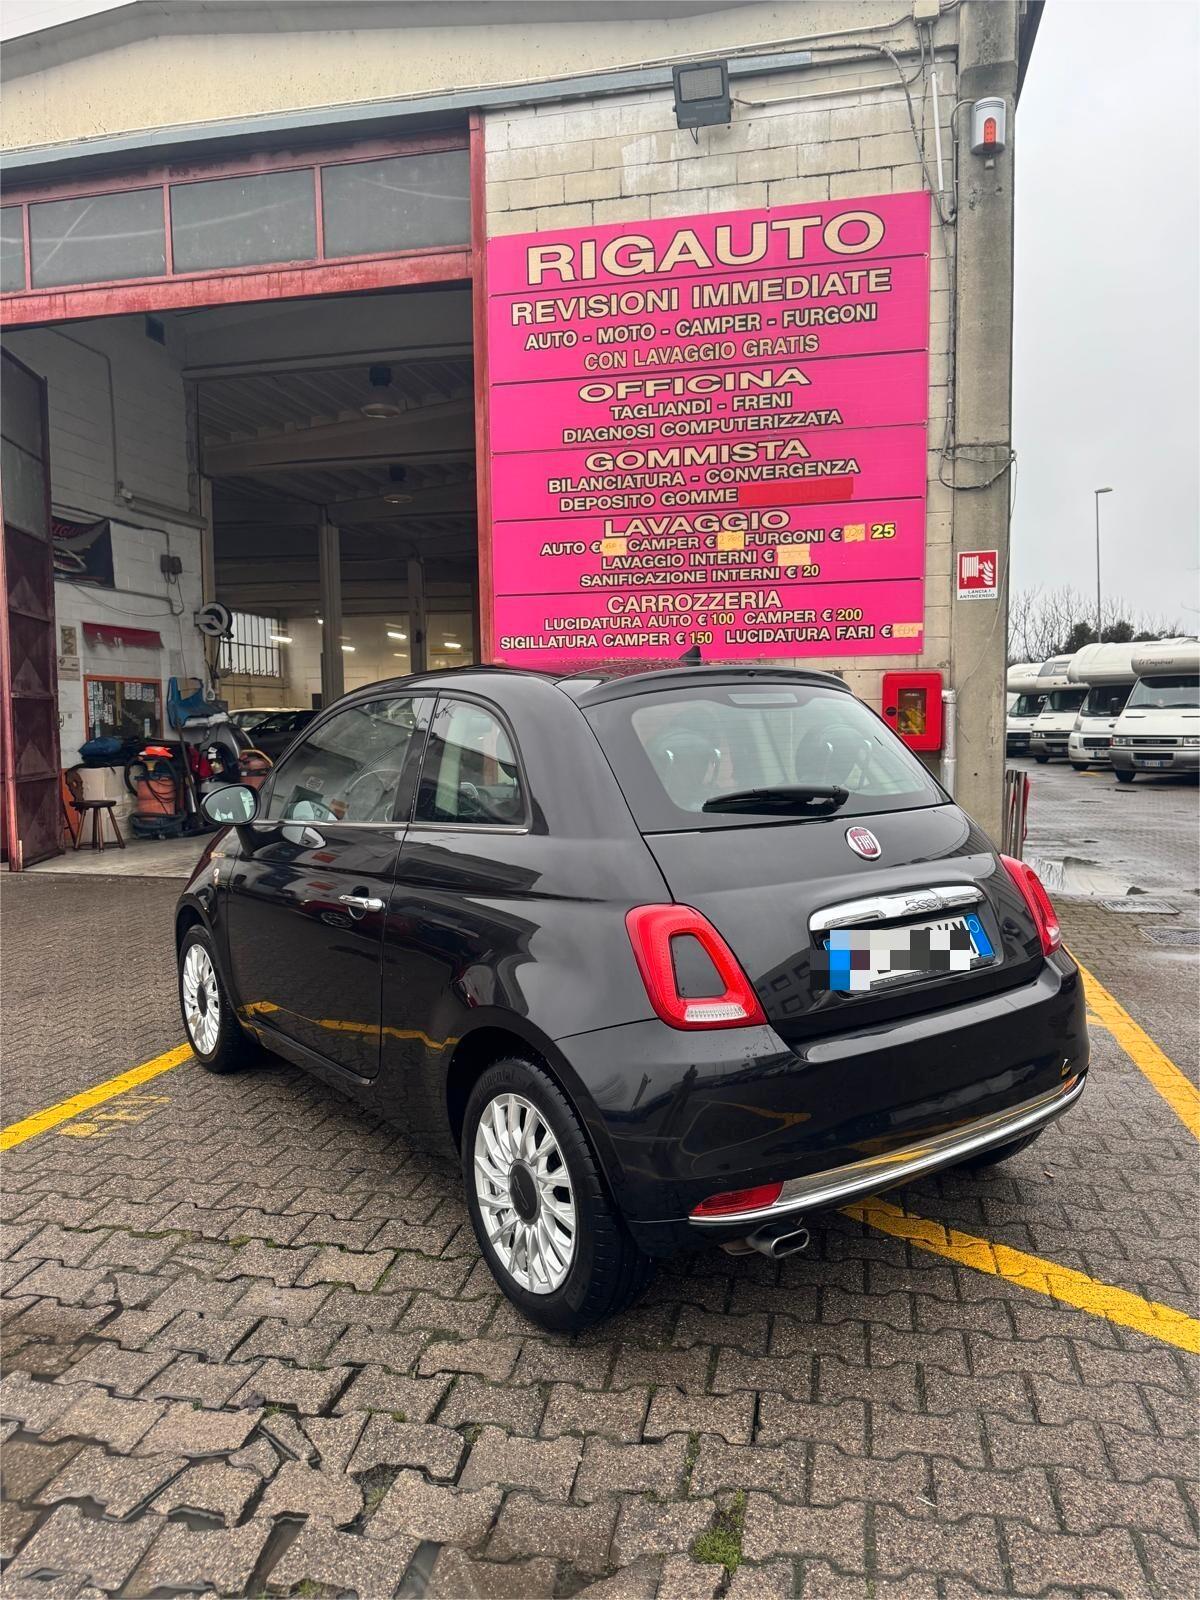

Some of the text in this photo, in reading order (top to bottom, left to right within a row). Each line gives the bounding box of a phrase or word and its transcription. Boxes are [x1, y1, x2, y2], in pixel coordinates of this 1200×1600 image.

[527, 211, 886, 286] RIGAUTO
[512, 267, 892, 326] REVISIONI IMMEDIATE
[524, 328, 578, 351] AUTO
[597, 323, 656, 344] MOTO
[674, 314, 761, 338] CAMPER
[782, 303, 878, 329] FURGONI
[583, 334, 820, 371] CON LAVAGGIO GRATIS
[578, 367, 811, 404] OFFICINA
[610, 402, 712, 421] TAGLIANDI
[732, 393, 792, 411] FRENI
[562, 409, 843, 444] DIAGNOSI COMPUTERIZZATA
[585, 438, 810, 472] GOMMISTA
[548, 472, 686, 494] BILANCIATURA
[704, 458, 860, 484] CONVERGENZA
[559, 487, 739, 512] DEPOSITO GOMME
[603, 510, 790, 538] LAVAGGIO
[540, 540, 586, 556] AUTO
[627, 536, 700, 552] CAMPER
[704, 535, 717, 548] €
[744, 528, 825, 546] FURGONI
[830, 528, 843, 541] €
[871, 523, 896, 539] 25
[601, 554, 686, 571] LAVAGGIO
[689, 550, 757, 566] INTERNI
[763, 549, 775, 562] €
[580, 564, 820, 587] SANIFICAZIONE INTERNI € 20
[606, 590, 783, 614] CARROZZERIA
[544, 607, 863, 631] LUCIDATURA AUTO € 100 CAMPER € 200
[500, 634, 598, 650] SIGILLATURA
[602, 632, 670, 647] CAMPER
[674, 632, 685, 645] €
[689, 631, 714, 644] 150
[725, 627, 830, 645] LUCIDATURA
[835, 624, 875, 639] FARI
[880, 624, 893, 638] €
[853, 835, 876, 851] FIAT
